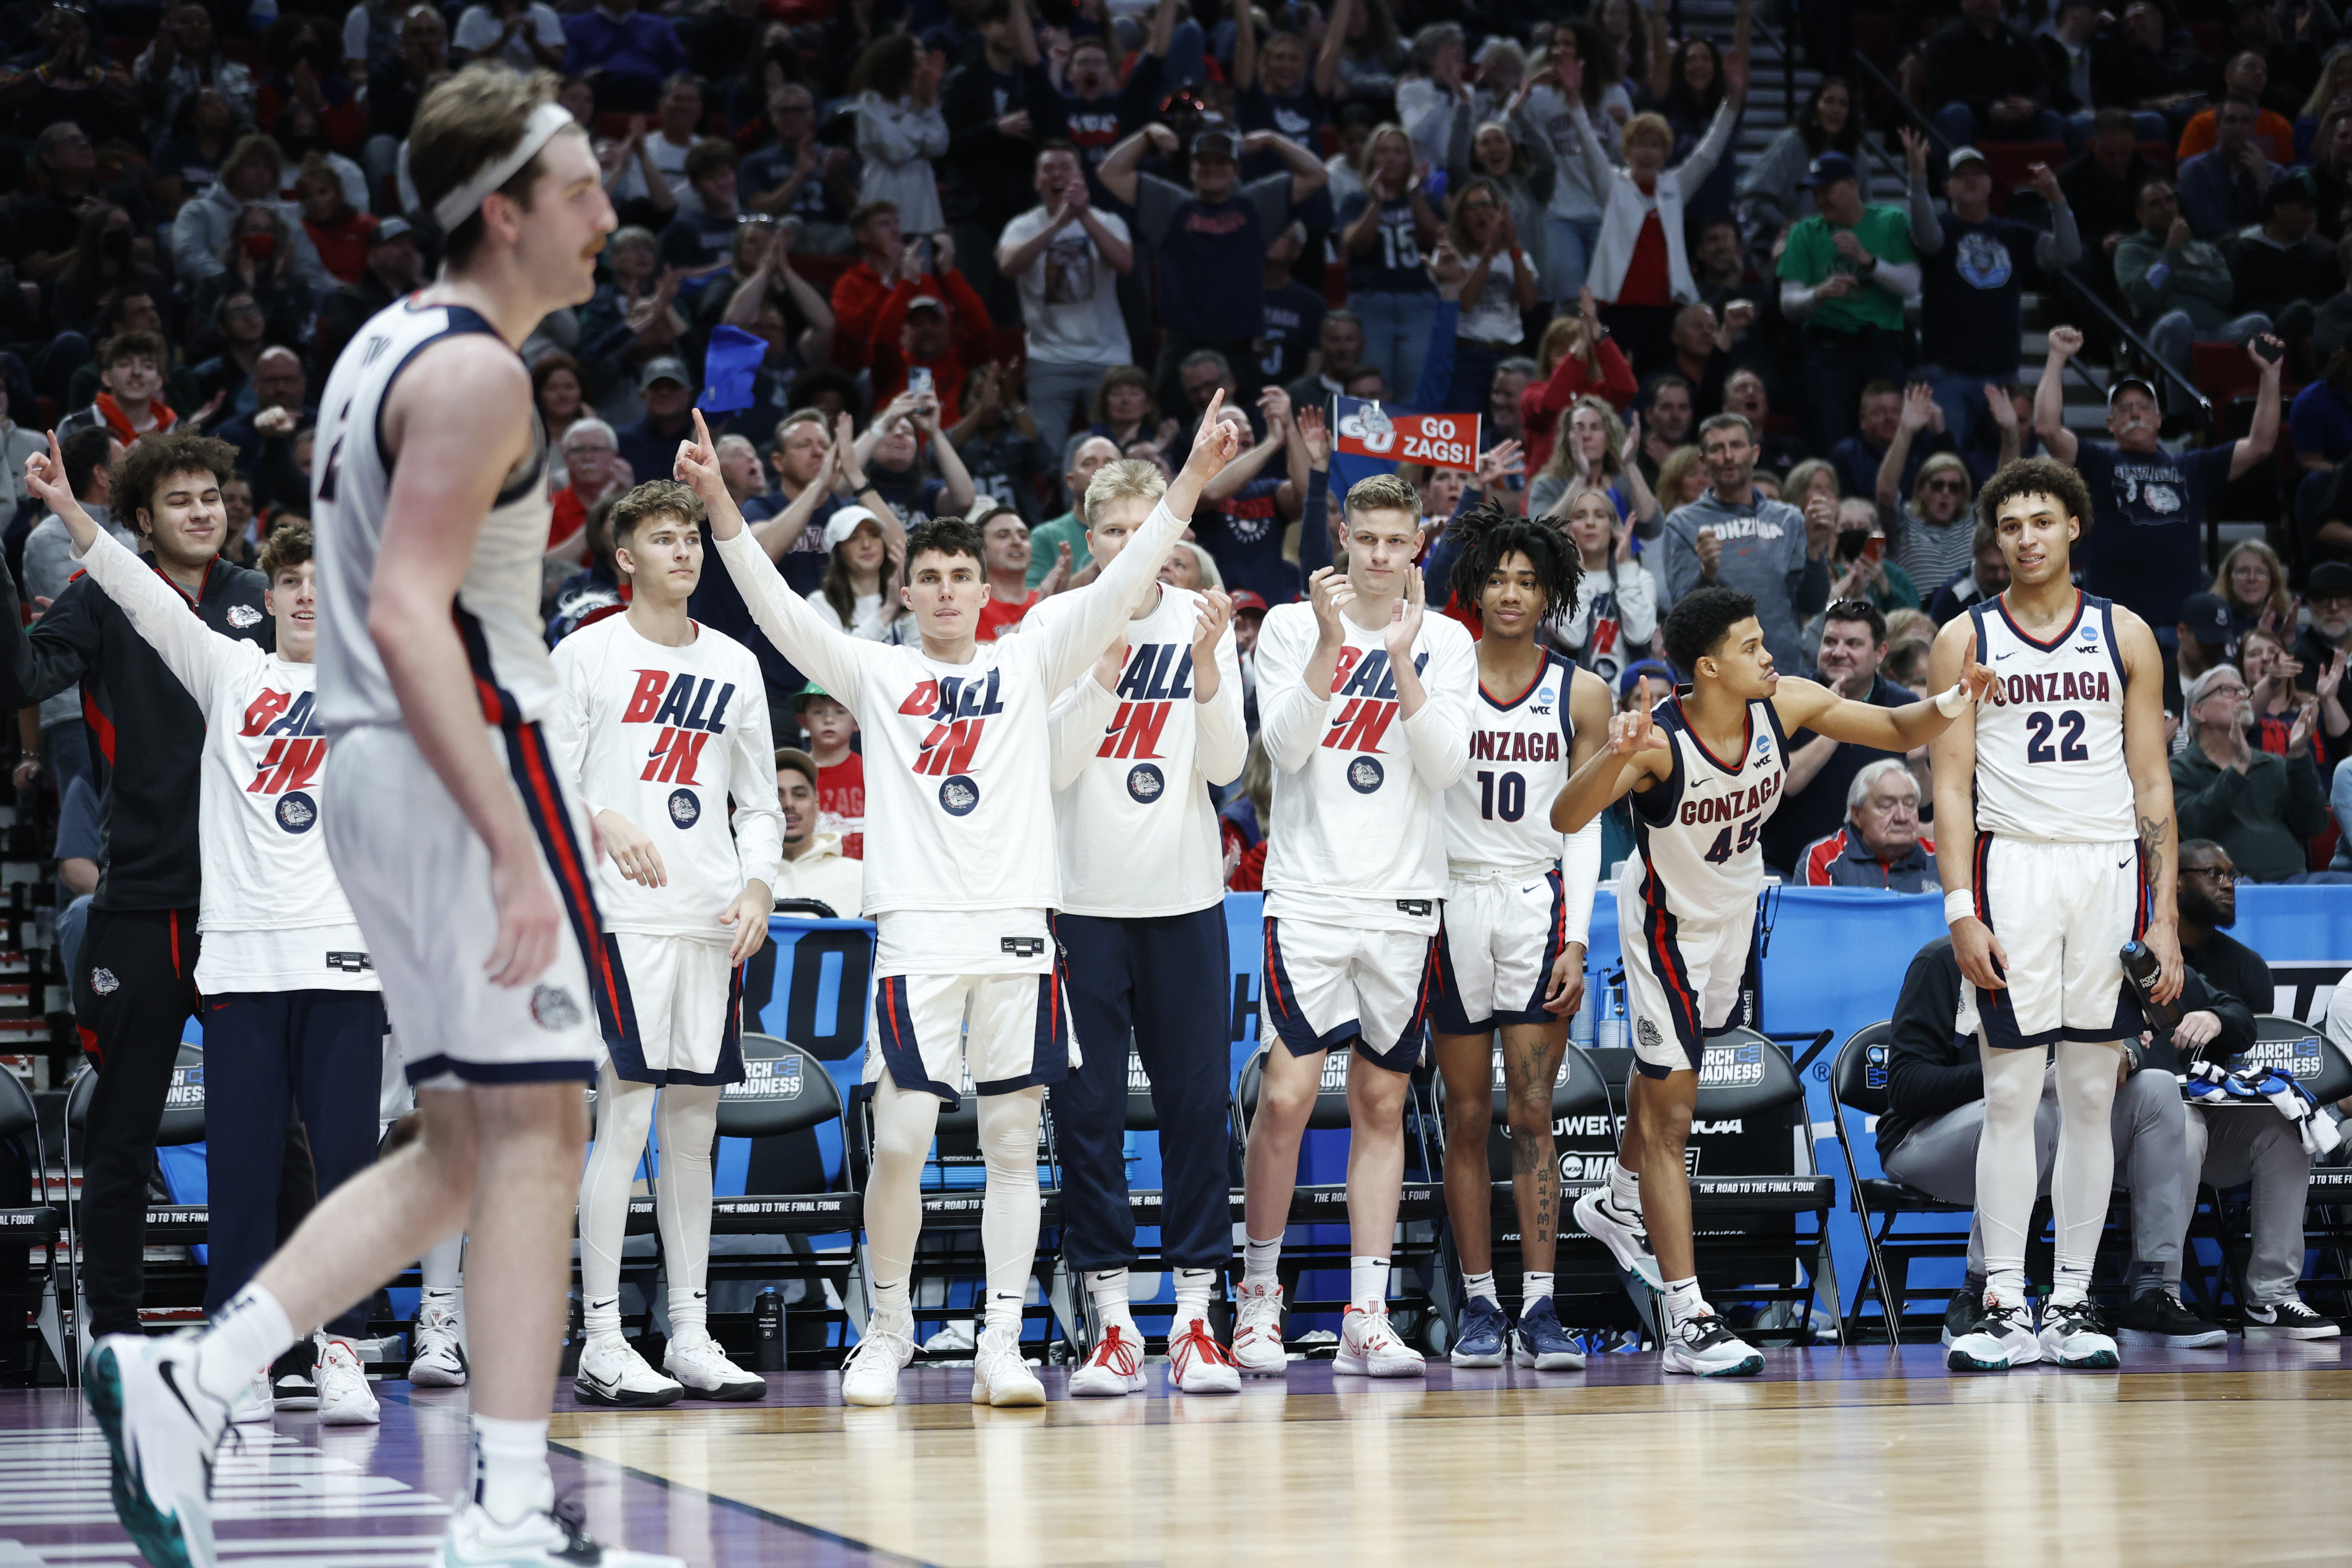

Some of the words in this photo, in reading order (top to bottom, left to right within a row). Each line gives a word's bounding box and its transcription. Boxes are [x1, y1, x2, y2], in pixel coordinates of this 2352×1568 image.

[1378, 222, 1420, 270] 15
[1421, 416, 1456, 440] GO
[1402, 435, 1471, 465] ZAGS!
[1114, 644, 1193, 700] ALL
[621, 669, 736, 735] BALL
[897, 666, 1004, 724] BALL
[1530, 706, 1551, 715] WCC
[1096, 701, 1167, 760] IN
[1321, 698, 1400, 754] IN
[2026, 710, 2089, 764] 22
[639, 727, 704, 787] IN
[912, 718, 982, 776] IN
[245, 738, 328, 795] IN
[1477, 771, 1526, 823] 10
[1681, 768, 1780, 826] GONZAGA
[1704, 810, 1762, 866] 45
[2139, 965, 2160, 984] POWER
[2141, 978, 2157, 988] ADE
[2244, 1042, 2293, 1059] MARCH
[1700, 1184, 1715, 1193] THE
[1716, 1183, 1738, 1193] ROAD
[1740, 1183, 1750, 1193] TO
[1752, 1183, 1767, 1193] THE
[1768, 1183, 1791, 1192] FINAL
[1793, 1182, 1814, 1192] FOUR
[2317, 1175, 2327, 1184] TO
[2328, 1175, 2343, 1184] THE
[631, 1203, 653, 1213] FOUR
[719, 1204, 735, 1213] THE
[736, 1204, 760, 1213] ROAD
[762, 1203, 772, 1212] TO
[774, 1203, 790, 1212] THE
[791, 1202, 816, 1211] FINAL
[818, 1201, 841, 1211] FOUR
[927, 1202, 943, 1210] THE
[944, 1201, 966, 1210] ROAD
[969, 1200, 980, 1209] TO
[1314, 1194, 1329, 1203] THE
[1409, 1191, 1430, 1200] FOUR
[11, 1215, 34, 1225] FOUR
[158, 1213, 169, 1222] TO
[172, 1213, 187, 1222] THE
